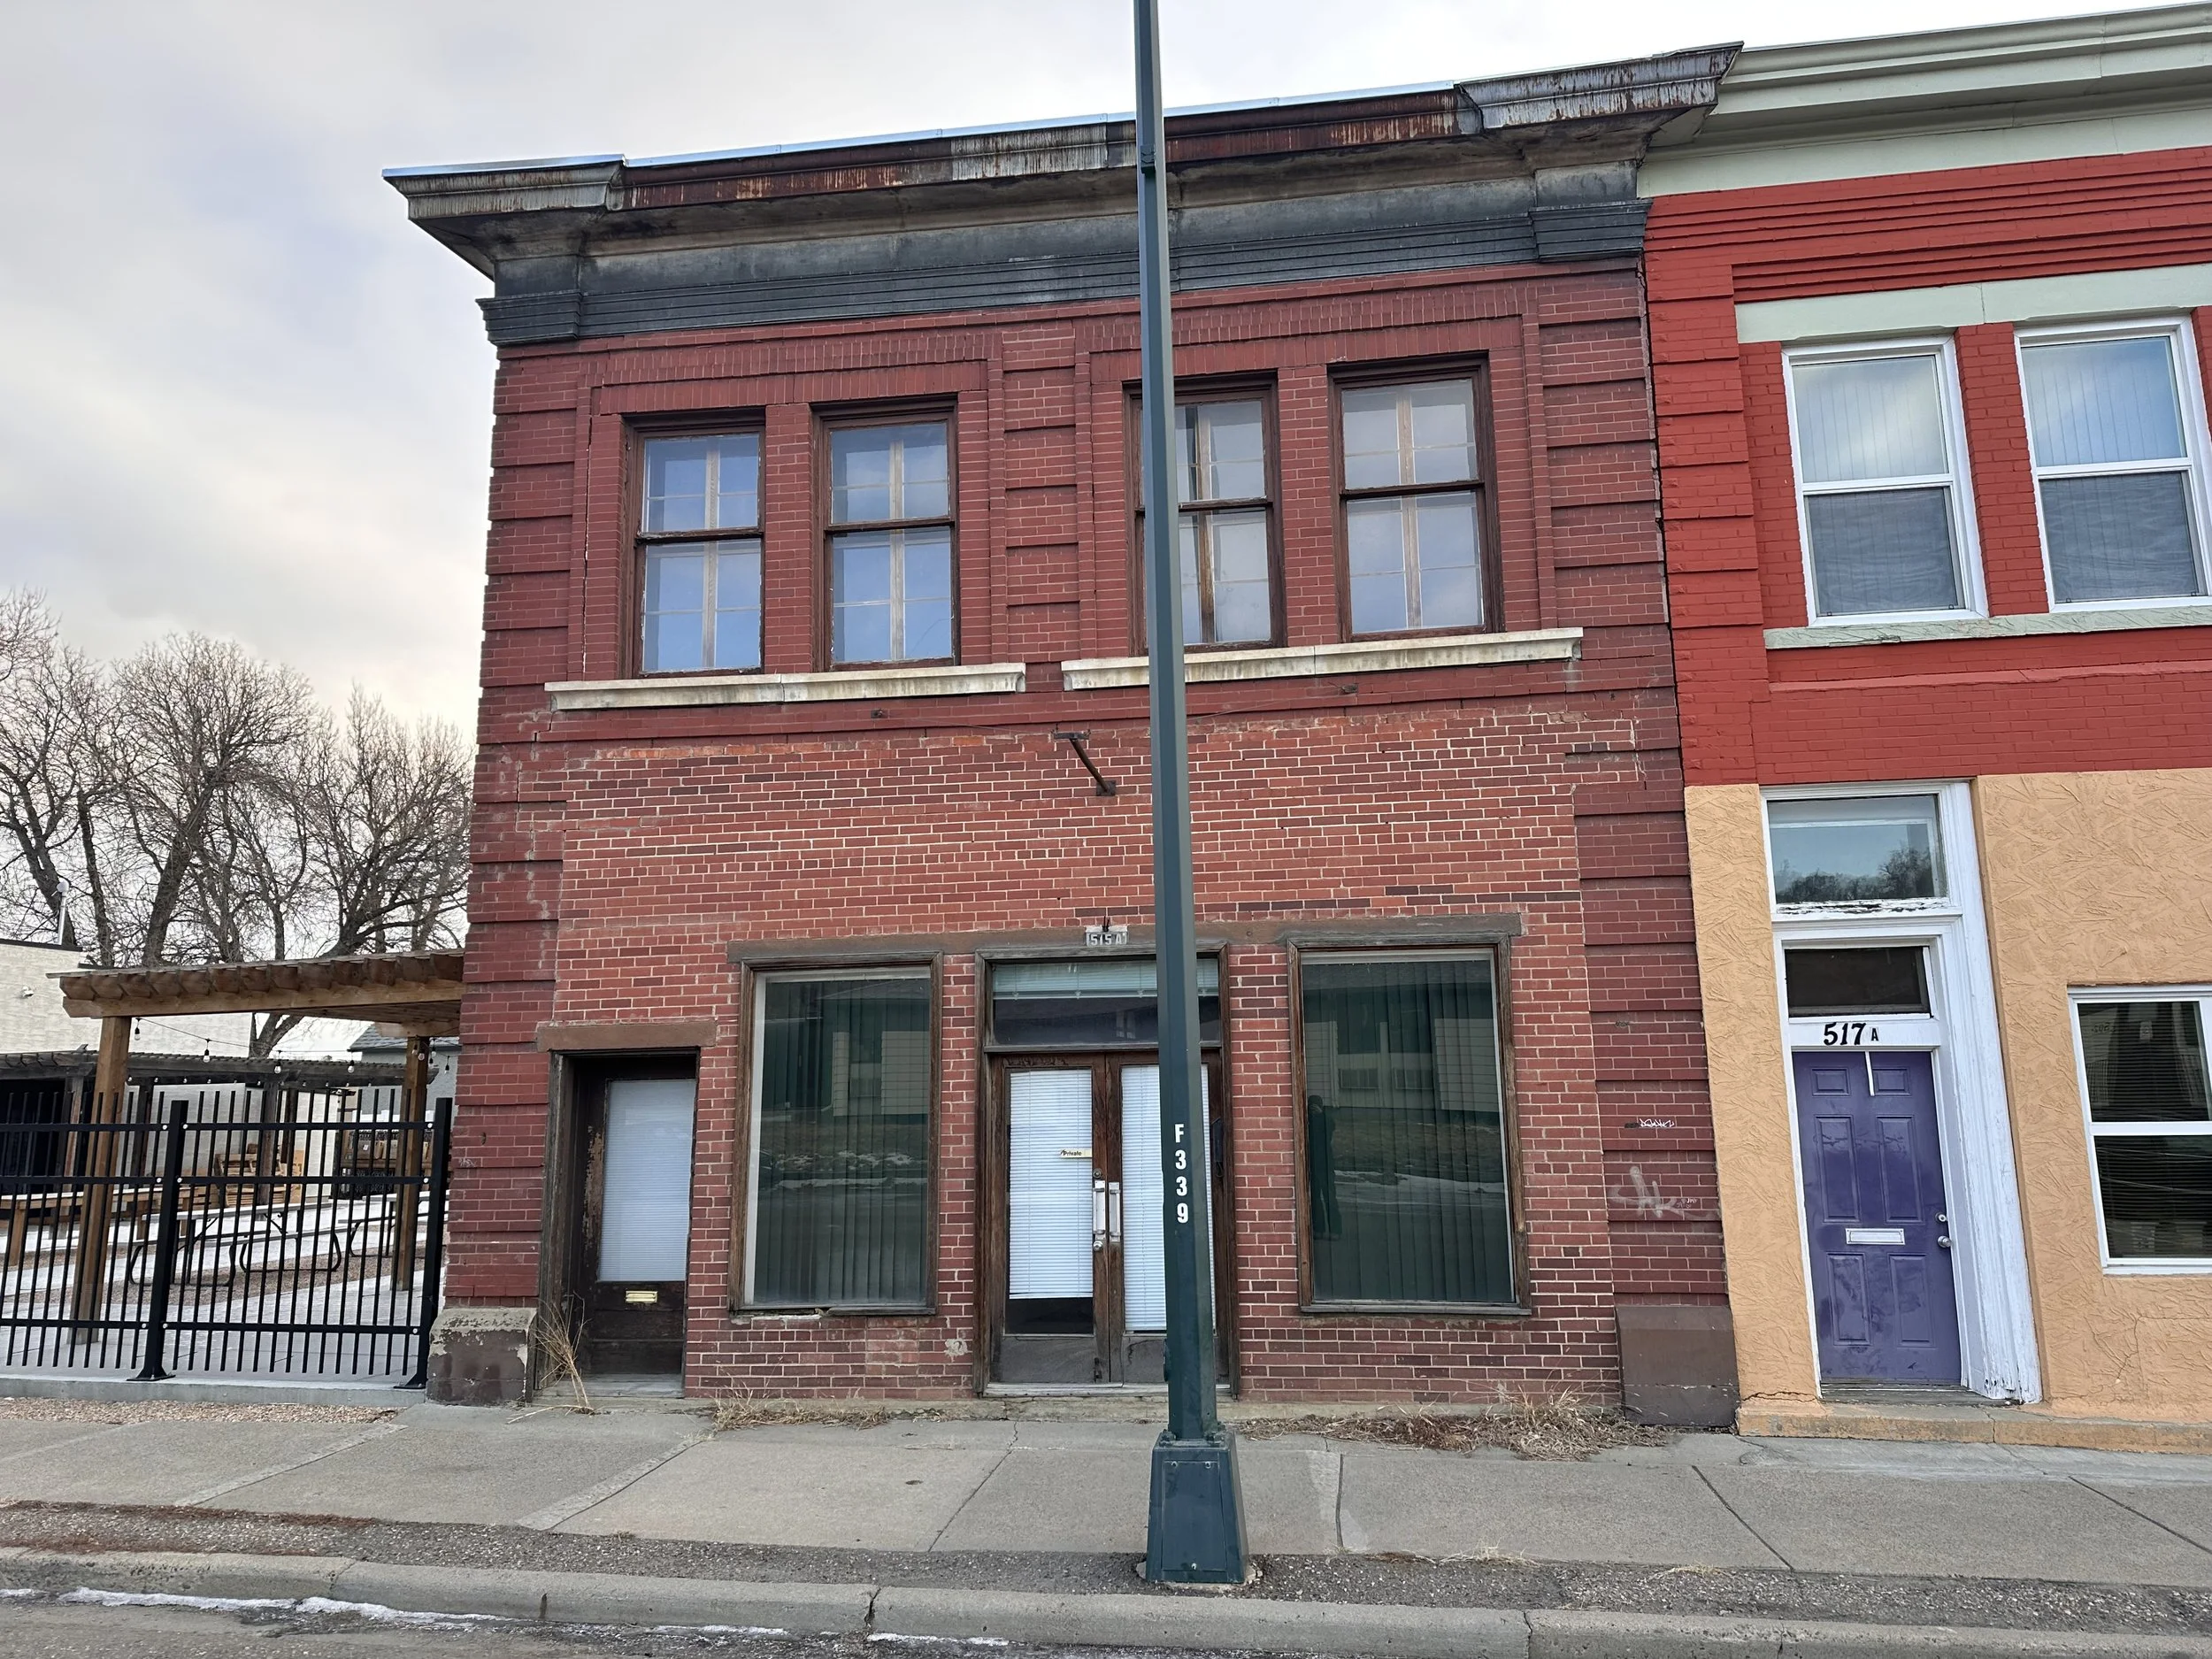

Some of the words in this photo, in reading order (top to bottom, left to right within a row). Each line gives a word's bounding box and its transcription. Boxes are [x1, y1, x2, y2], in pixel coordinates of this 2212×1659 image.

[1090, 933, 1112, 946] 515
[1824, 1022, 1867, 1046] 517
[1870, 1028, 1879, 1041] A
[1174, 1123, 1189, 1224] F339
